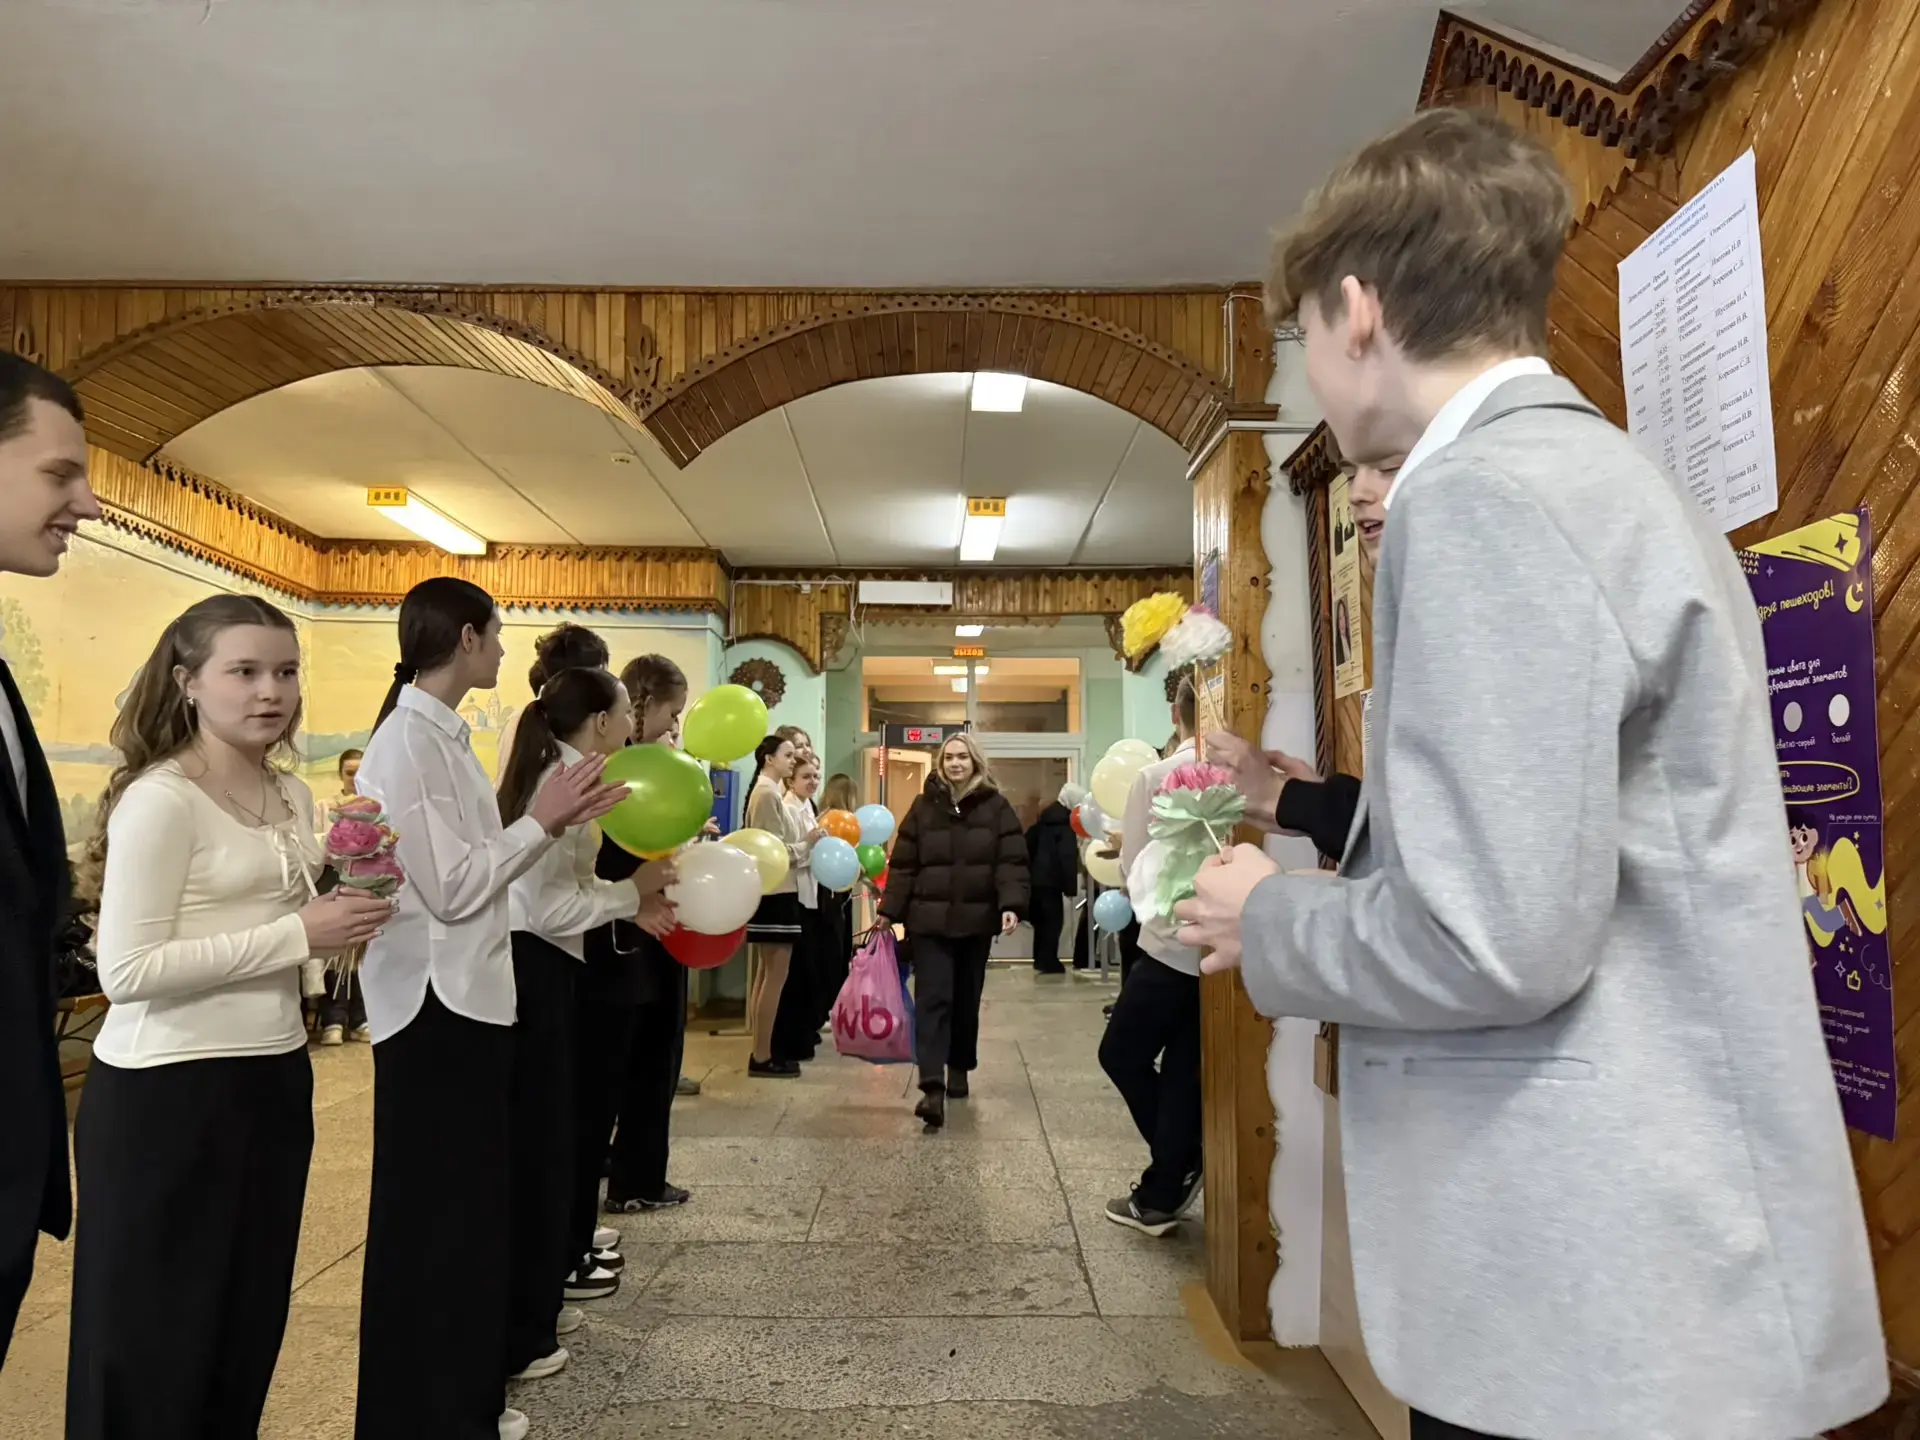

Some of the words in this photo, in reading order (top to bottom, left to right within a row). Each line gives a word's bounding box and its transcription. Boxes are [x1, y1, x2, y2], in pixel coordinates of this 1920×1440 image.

[1757, 601, 1777, 624] друг
[1780, 579, 1835, 610] пешеходов!
[1787, 659, 1807, 673] цвета
[1807, 658, 1821, 675] для
[1812, 664, 1848, 684] элементов
[1831, 732, 1851, 744] белый
